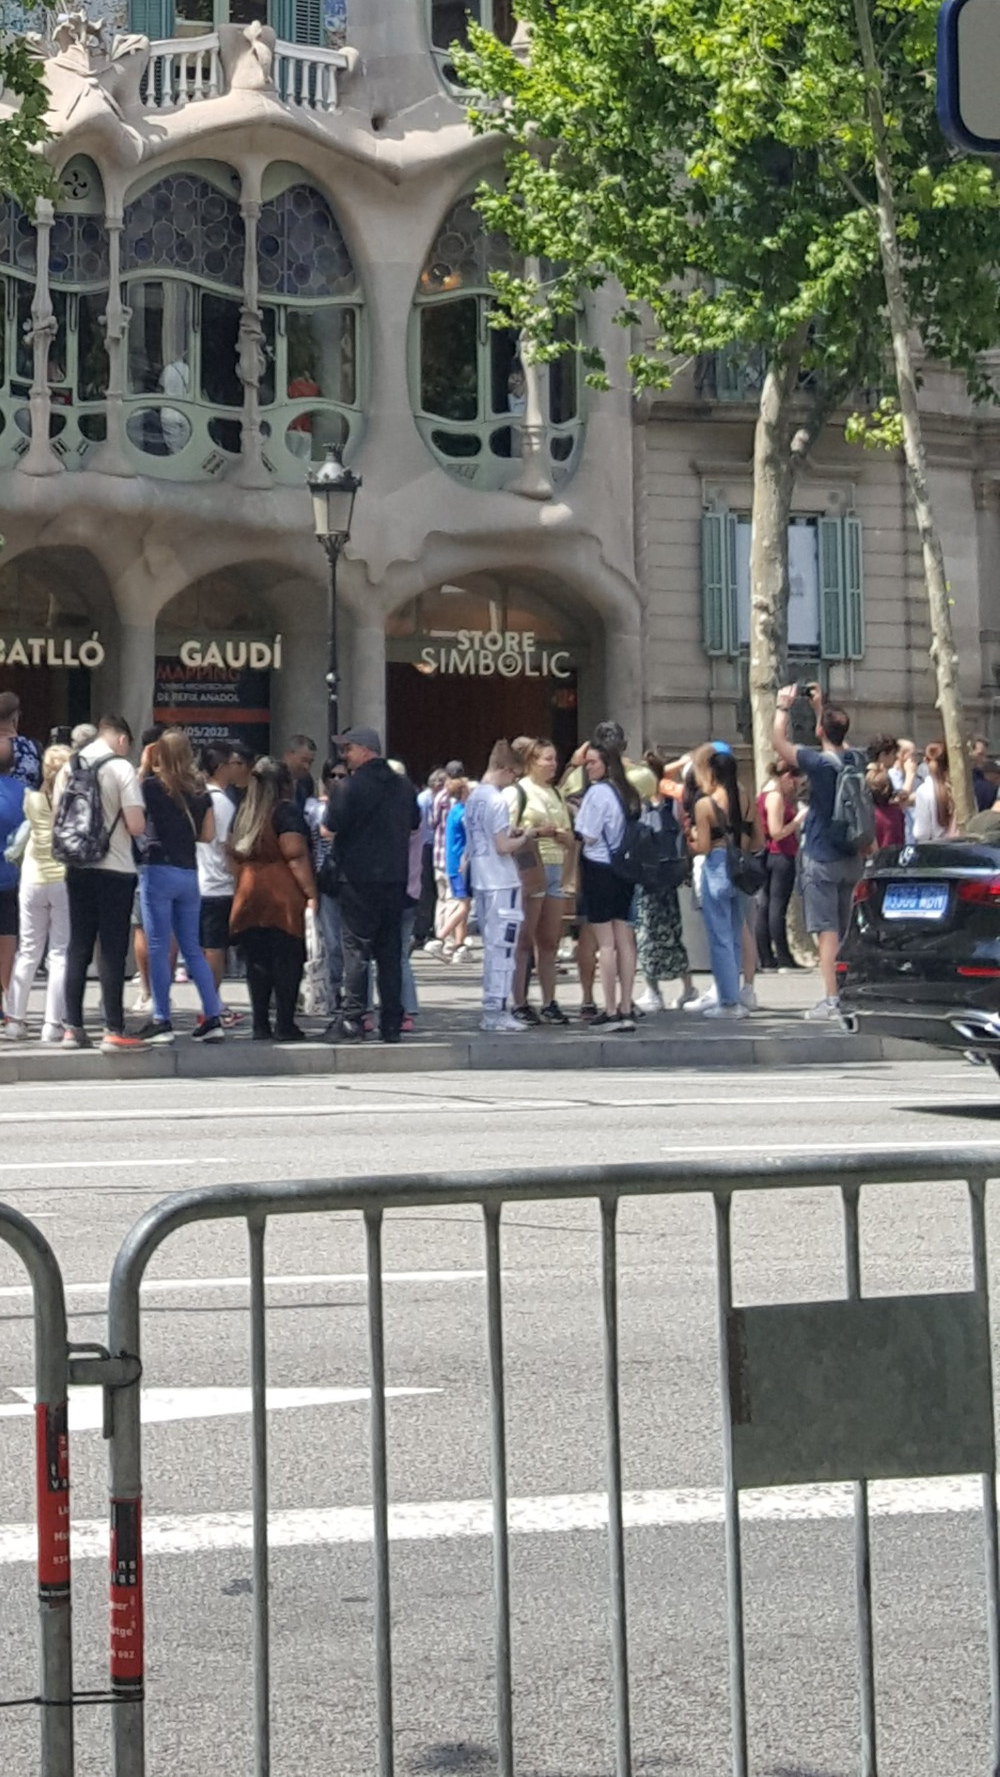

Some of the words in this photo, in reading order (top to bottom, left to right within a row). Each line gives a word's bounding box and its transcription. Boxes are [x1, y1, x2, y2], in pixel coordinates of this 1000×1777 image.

[180, 633, 282, 670] GAUDÍ
[457, 629, 536, 652] STORE
[421, 647, 571, 678] SIMBOLIC
